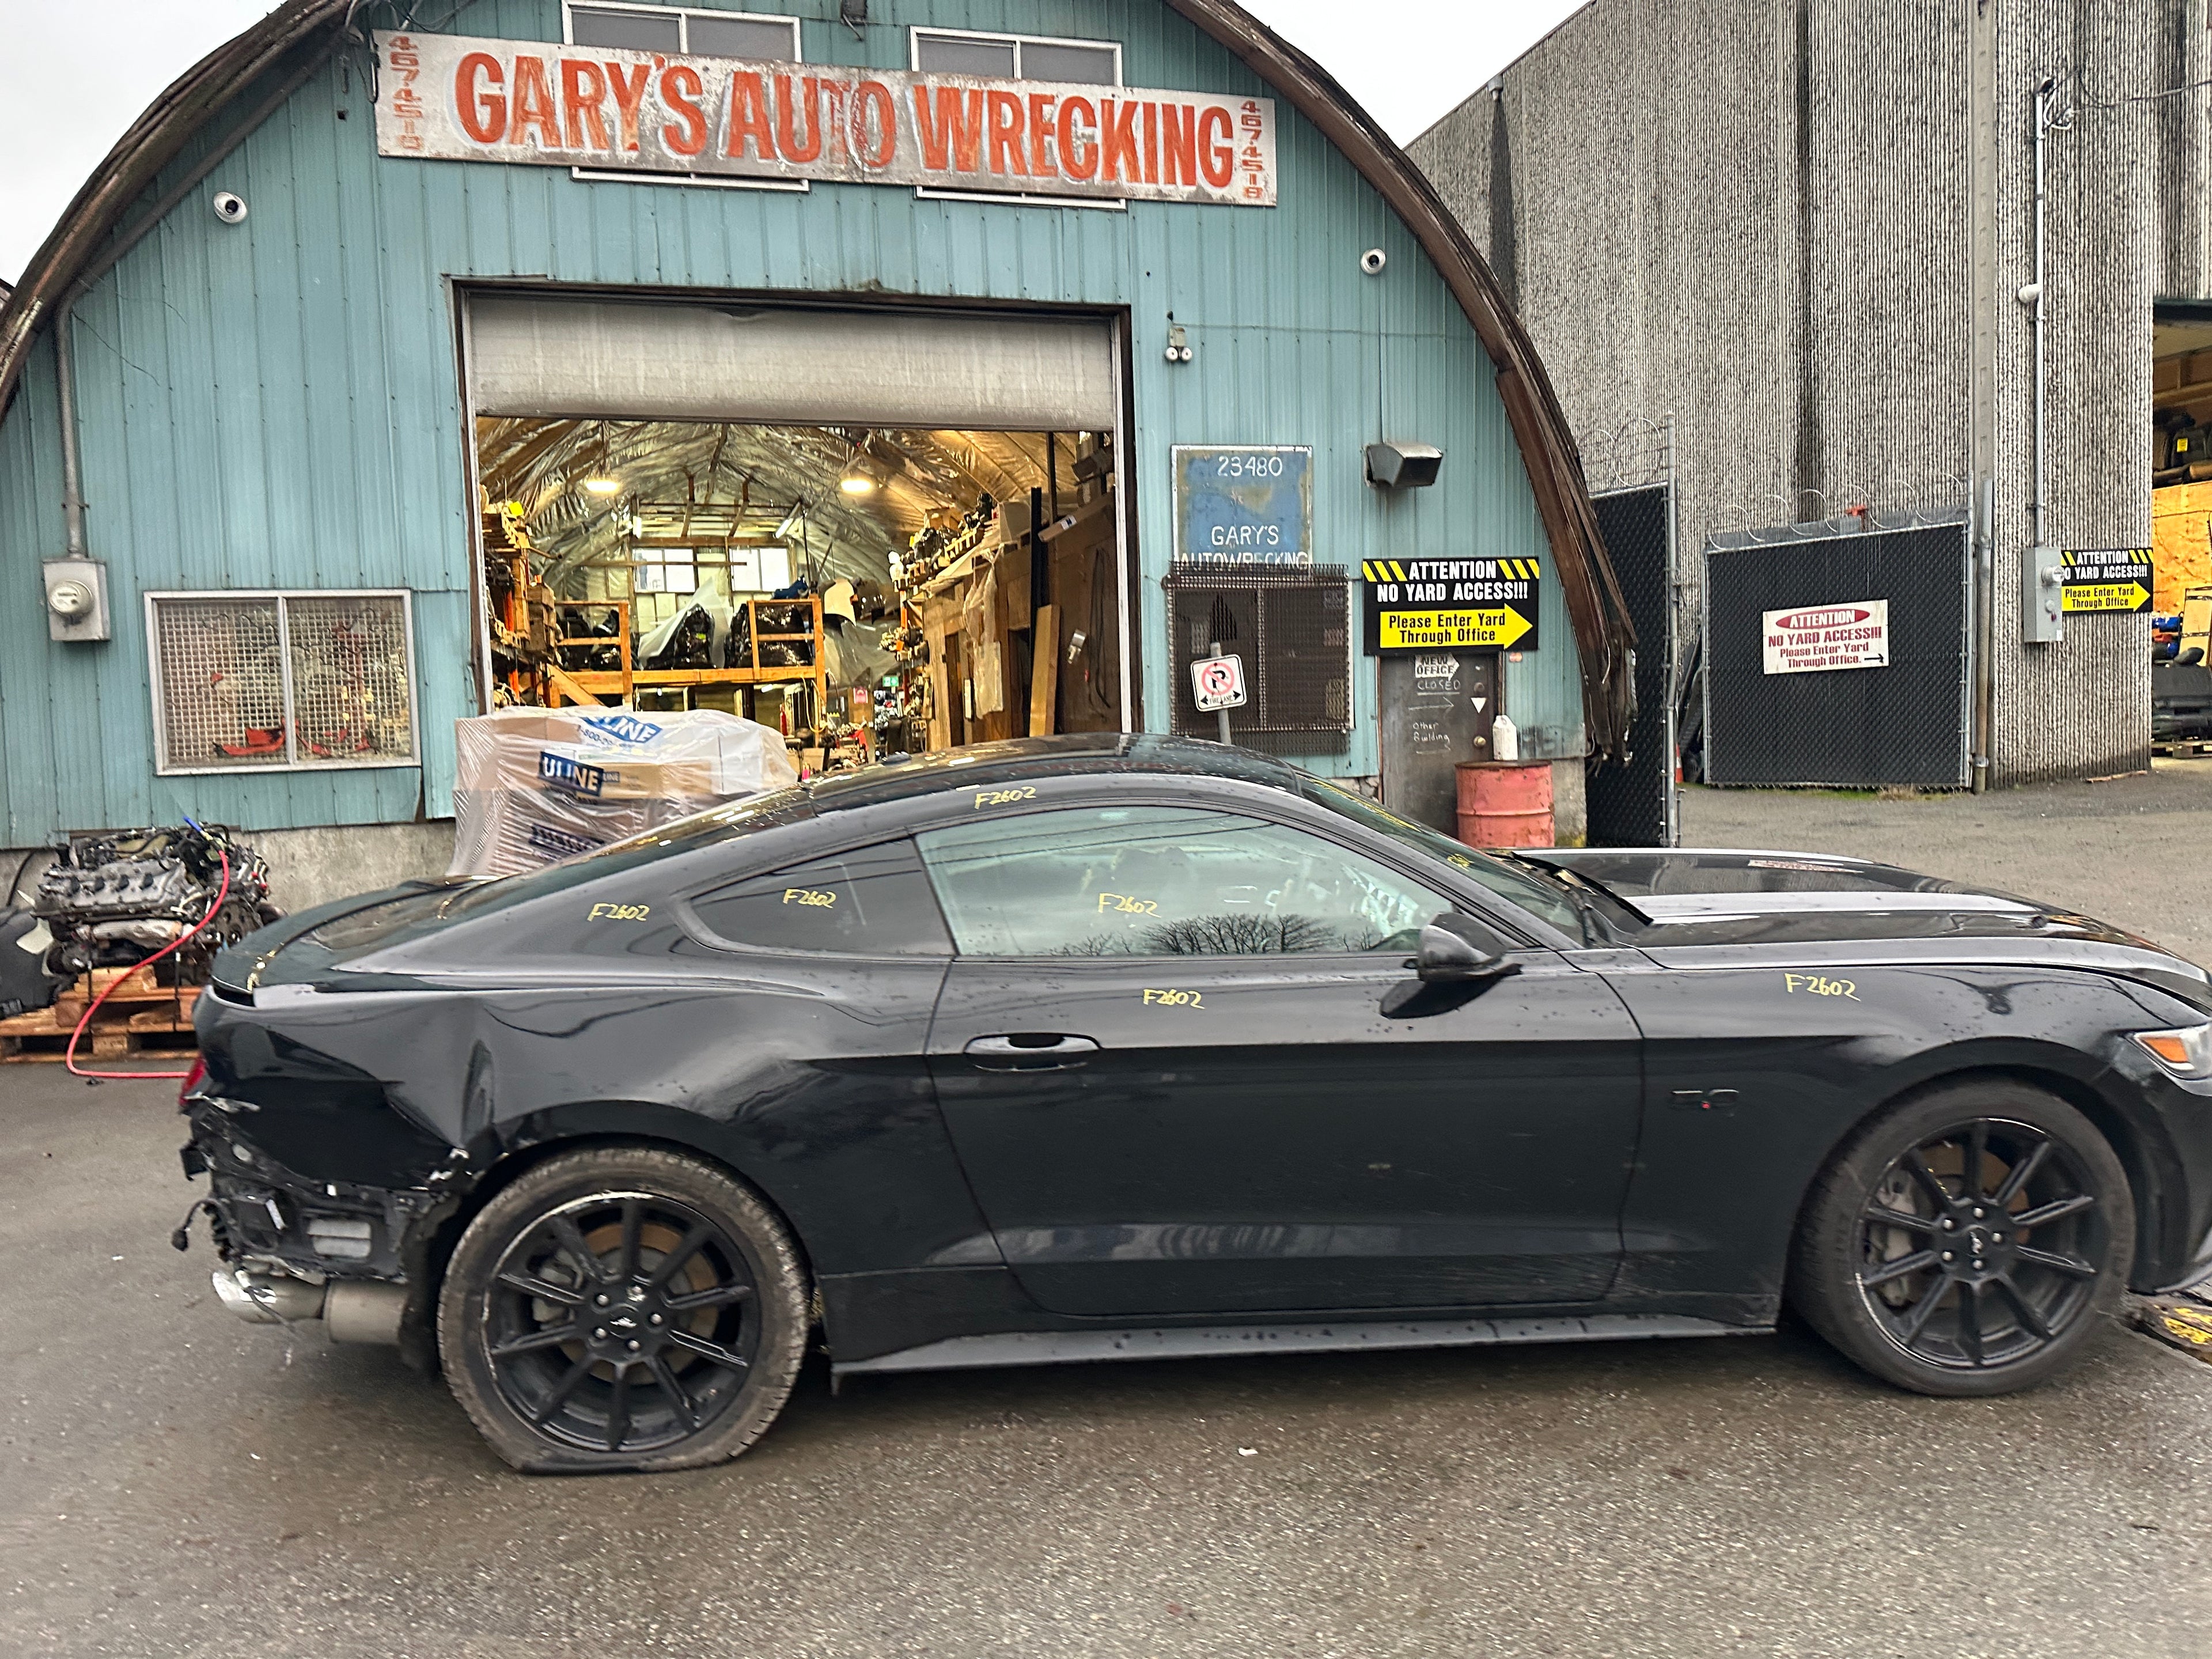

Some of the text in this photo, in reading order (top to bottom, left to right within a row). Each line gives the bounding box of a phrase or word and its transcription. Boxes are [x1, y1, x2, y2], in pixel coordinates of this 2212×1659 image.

[454, 51, 1234, 189] GARY'S AUTO WRECKING
[1217, 455, 1283, 477] 23480
[1211, 525, 1279, 546] GARY'S
[2076, 550, 2129, 565] ATTENTION
[1408, 560, 1497, 580] ATTENTION
[2074, 566, 2099, 579] YARD
[2103, 565, 2147, 578] ACCESS!!!
[1377, 581, 1528, 603] NO YARD ACCESS!!!
[2065, 586, 2135, 599] Please Enter Yard
[2071, 597, 2128, 609] Through Office
[1389, 612, 1506, 628] Please Enter Yard
[1789, 609, 1856, 628] ATTENTION
[1399, 627, 1495, 645] Through Office
[1768, 626, 1882, 647] NO YARD ACCESS!!!
[1421, 655, 1448, 665] NEW
[1779, 642, 1869, 658] Please Enter Yard
[1787, 656, 1826, 669] Through
[1417, 679, 1461, 691] CLOSED
[543, 756, 599, 792] ULINE
[974, 786, 1037, 810] F2602
[783, 888, 836, 909] F2602
[1097, 892, 1162, 918] F2602
[586, 902, 650, 922] F2602
[1784, 972, 1862, 1002] F2602
[1143, 988, 1206, 1009] F2602
